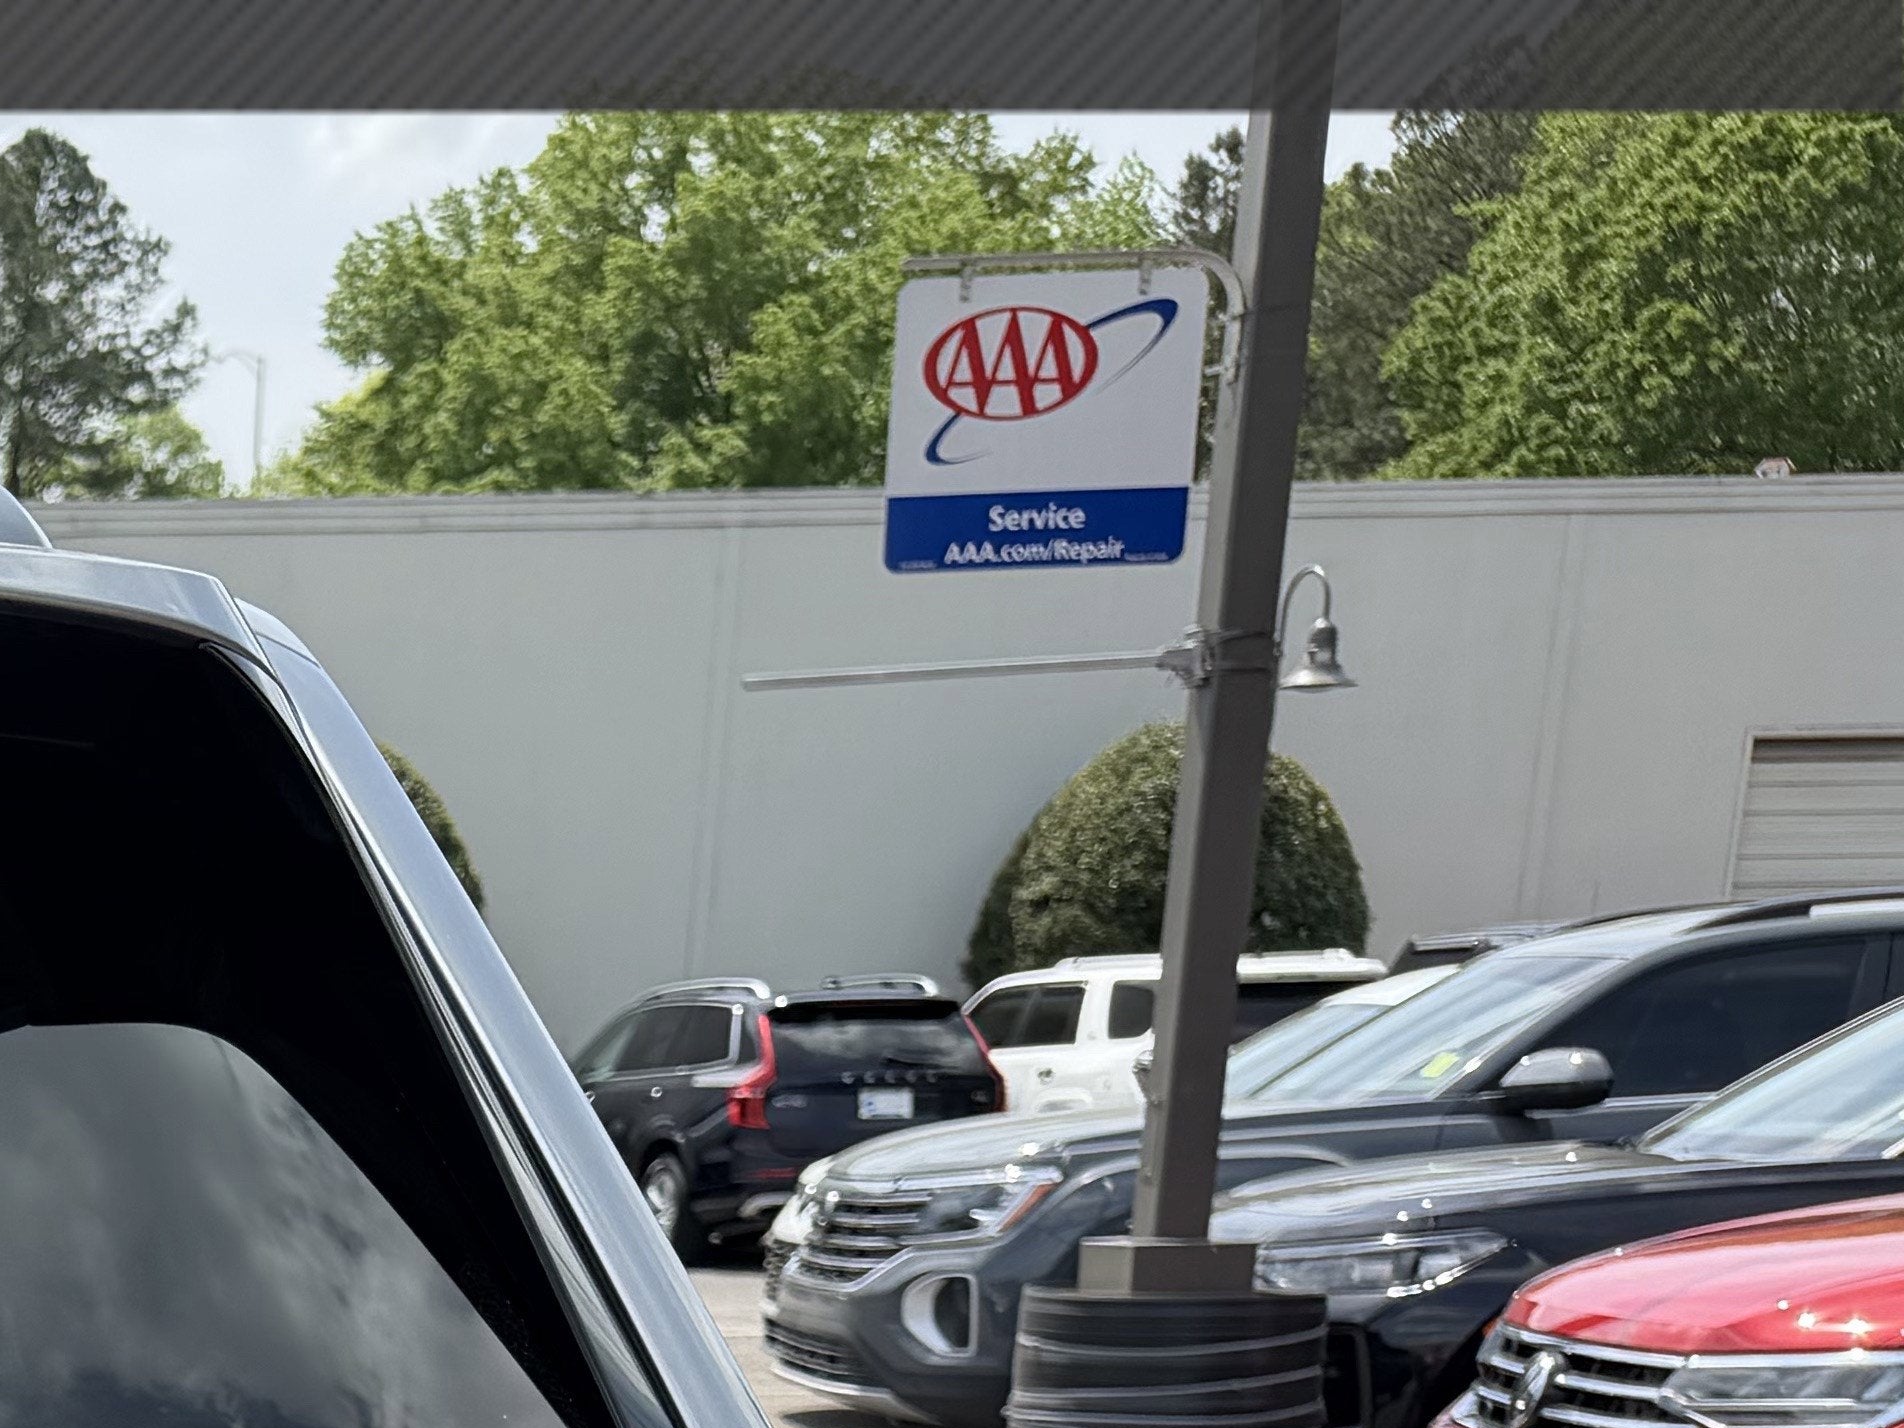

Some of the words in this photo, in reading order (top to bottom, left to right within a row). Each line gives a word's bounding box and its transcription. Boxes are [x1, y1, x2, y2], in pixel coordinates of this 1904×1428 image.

[930, 306, 1092, 420] AAA
[988, 502, 1087, 534] Service
[943, 536, 1125, 564] AAA.com/Repair
